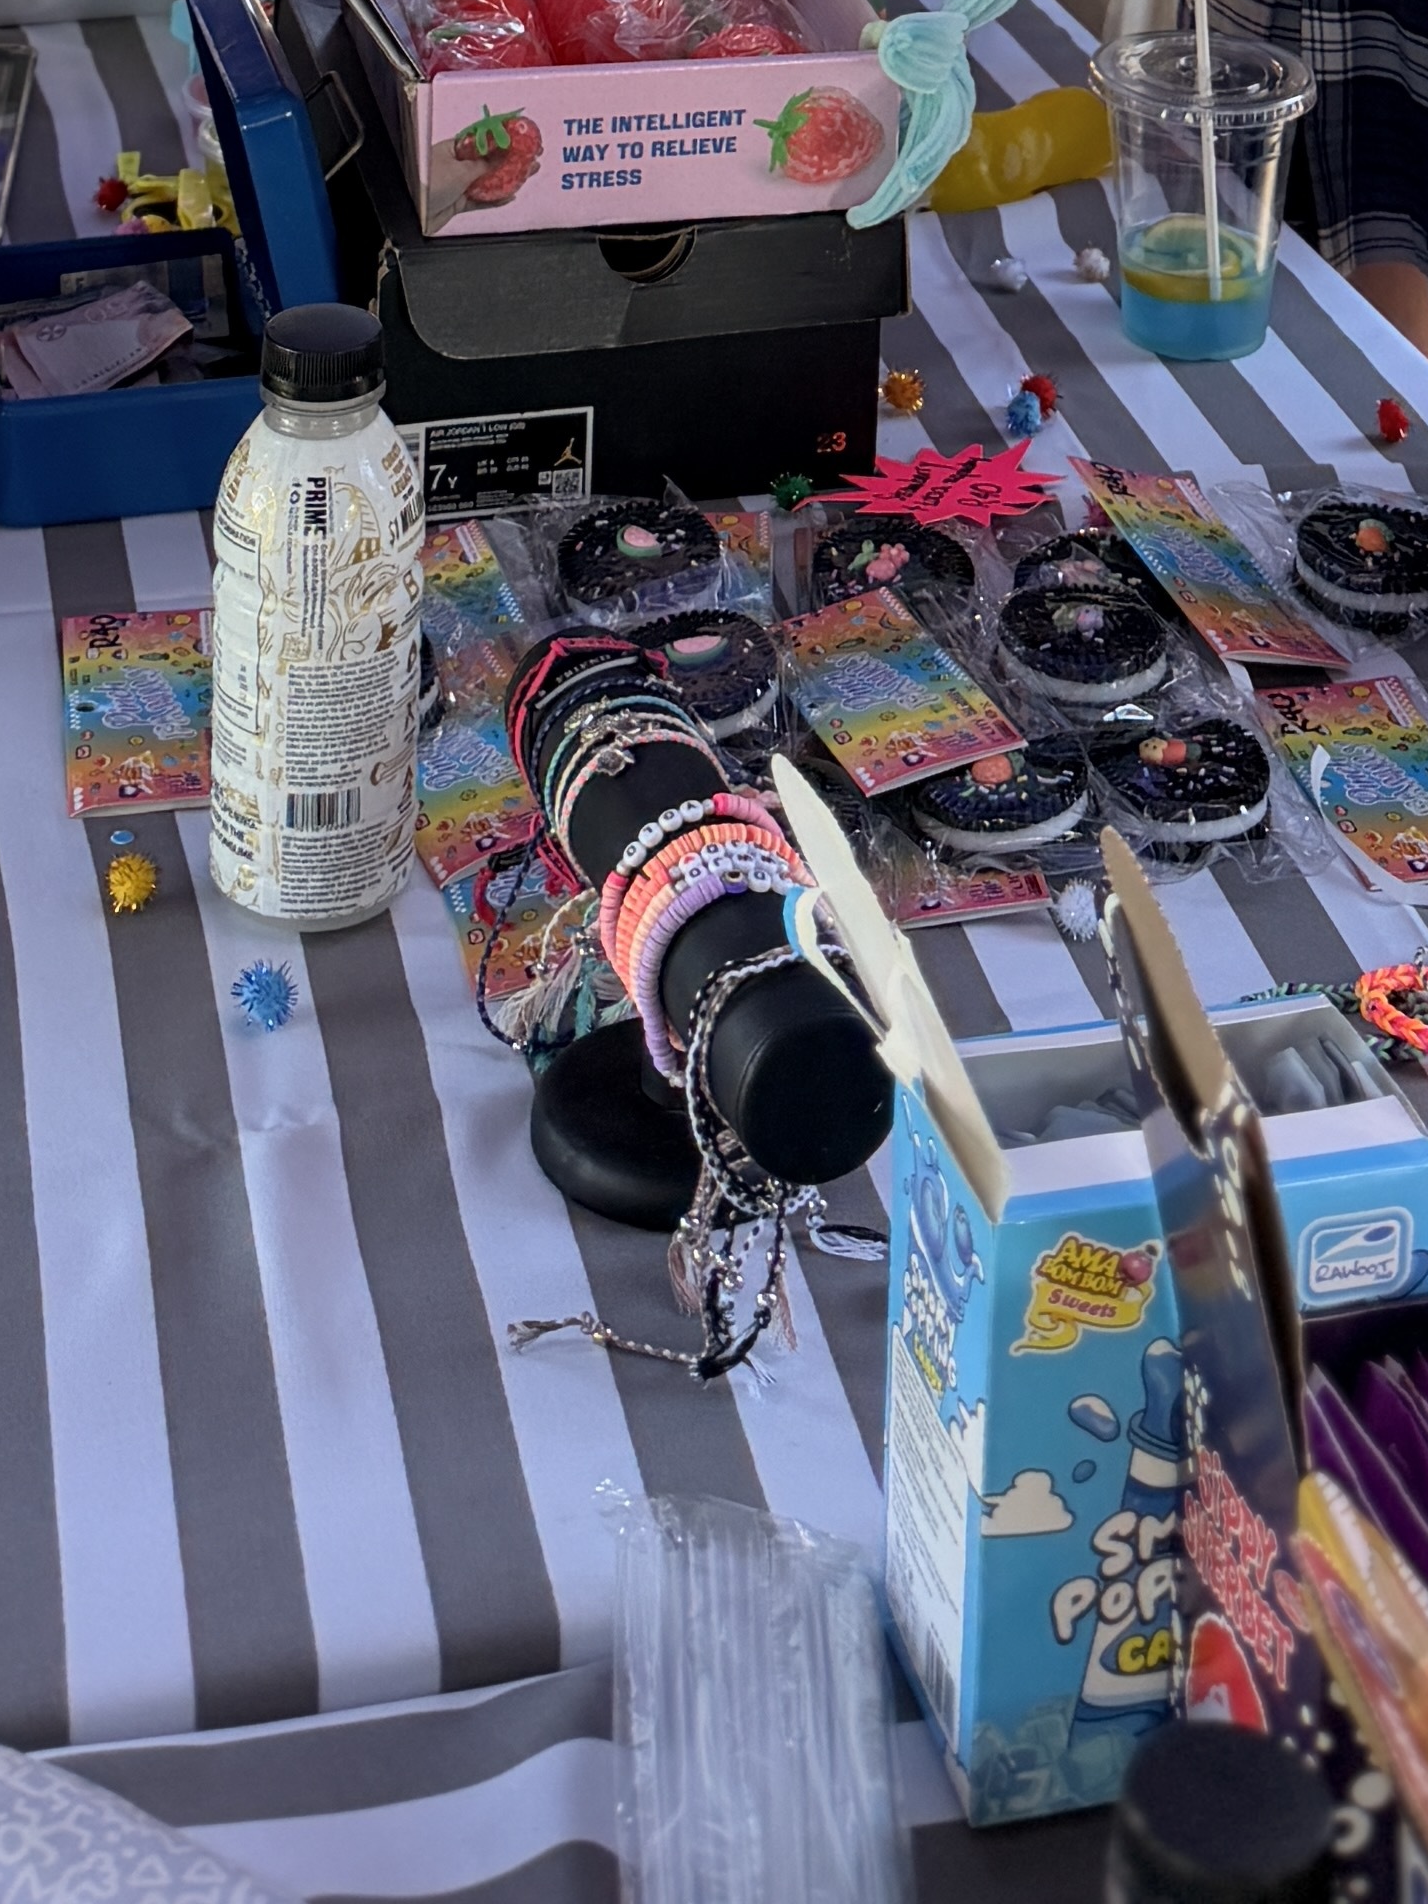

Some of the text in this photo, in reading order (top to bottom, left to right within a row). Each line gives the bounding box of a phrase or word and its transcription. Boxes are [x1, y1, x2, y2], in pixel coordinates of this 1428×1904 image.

[563, 109, 747, 136] THE INTELLIGENT
[562, 136, 737, 163] WAY TO RELIEVE
[561, 168, 642, 190] STRESS
[1057, 1238, 1121, 1279] AMA
[1047, 1287, 1118, 1318] Sweets
[1117, 1628, 1172, 1674] CA
